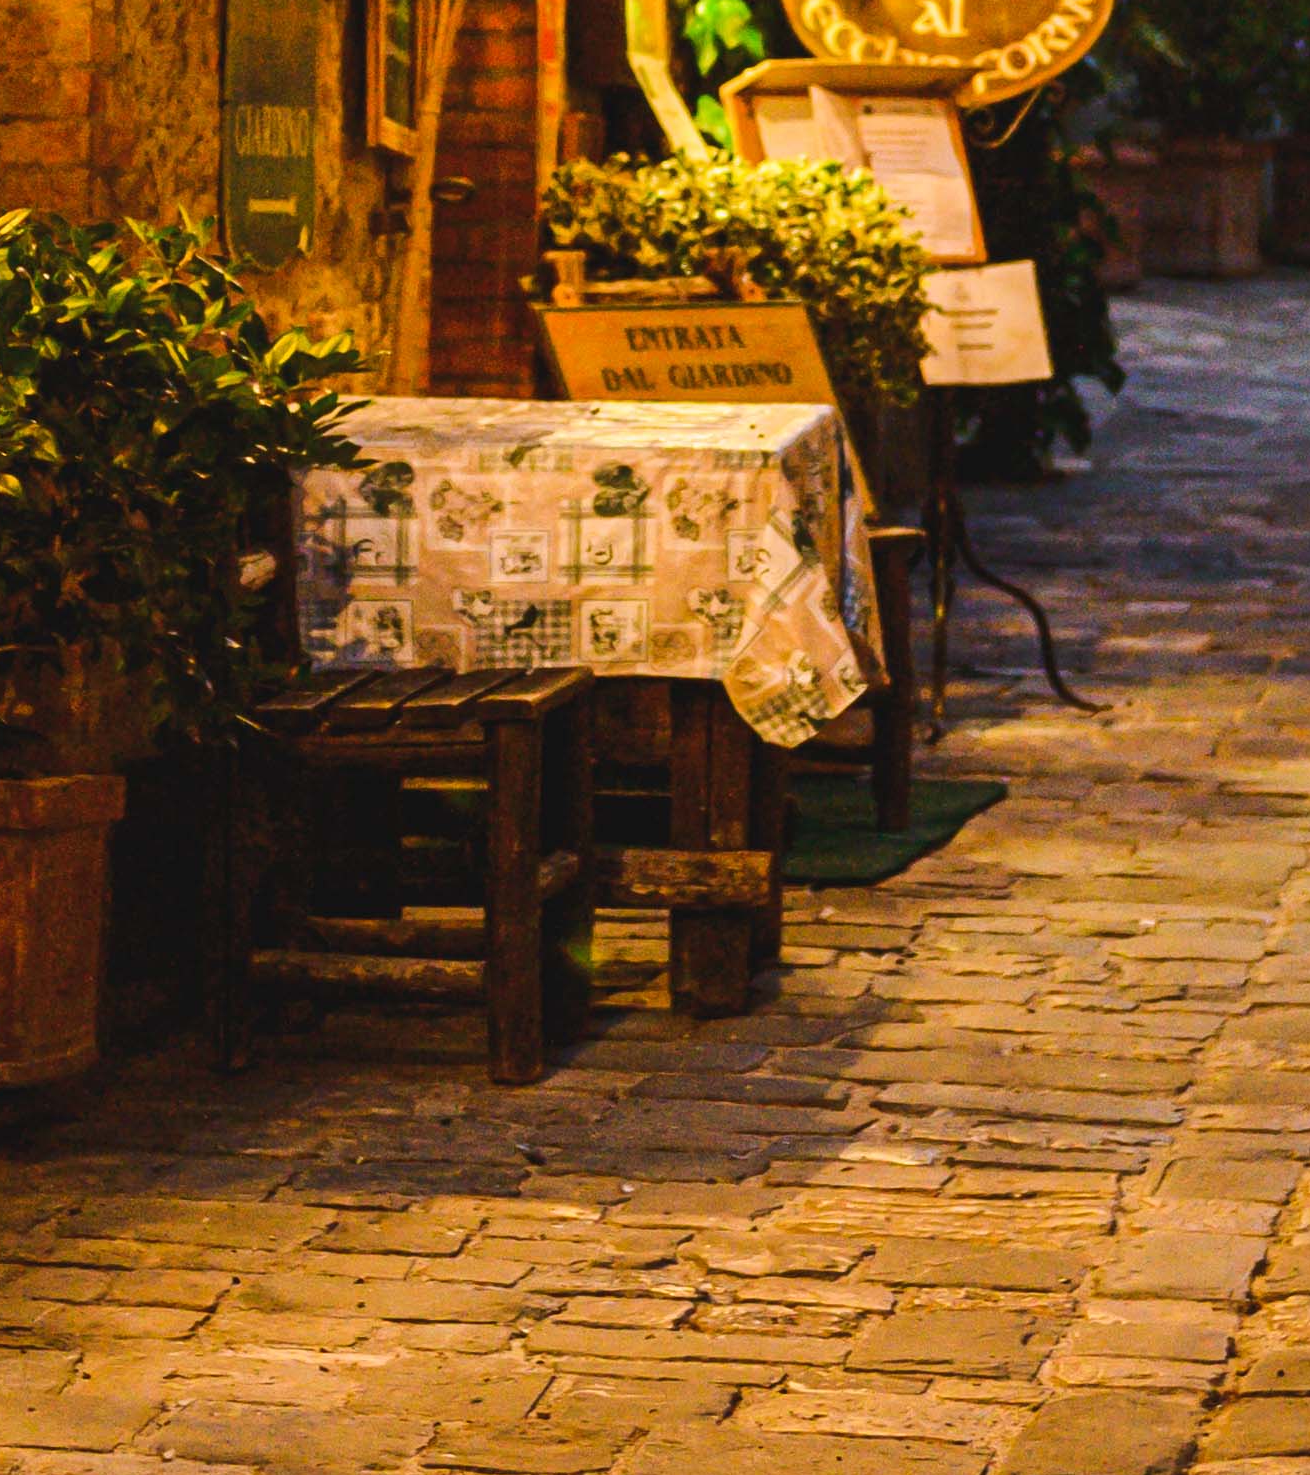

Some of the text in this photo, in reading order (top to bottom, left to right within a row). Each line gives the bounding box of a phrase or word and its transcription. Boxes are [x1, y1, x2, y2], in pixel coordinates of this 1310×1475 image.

[624, 324, 747, 353] ENTRATA
[601, 361, 793, 393] DAL GIARDINO
